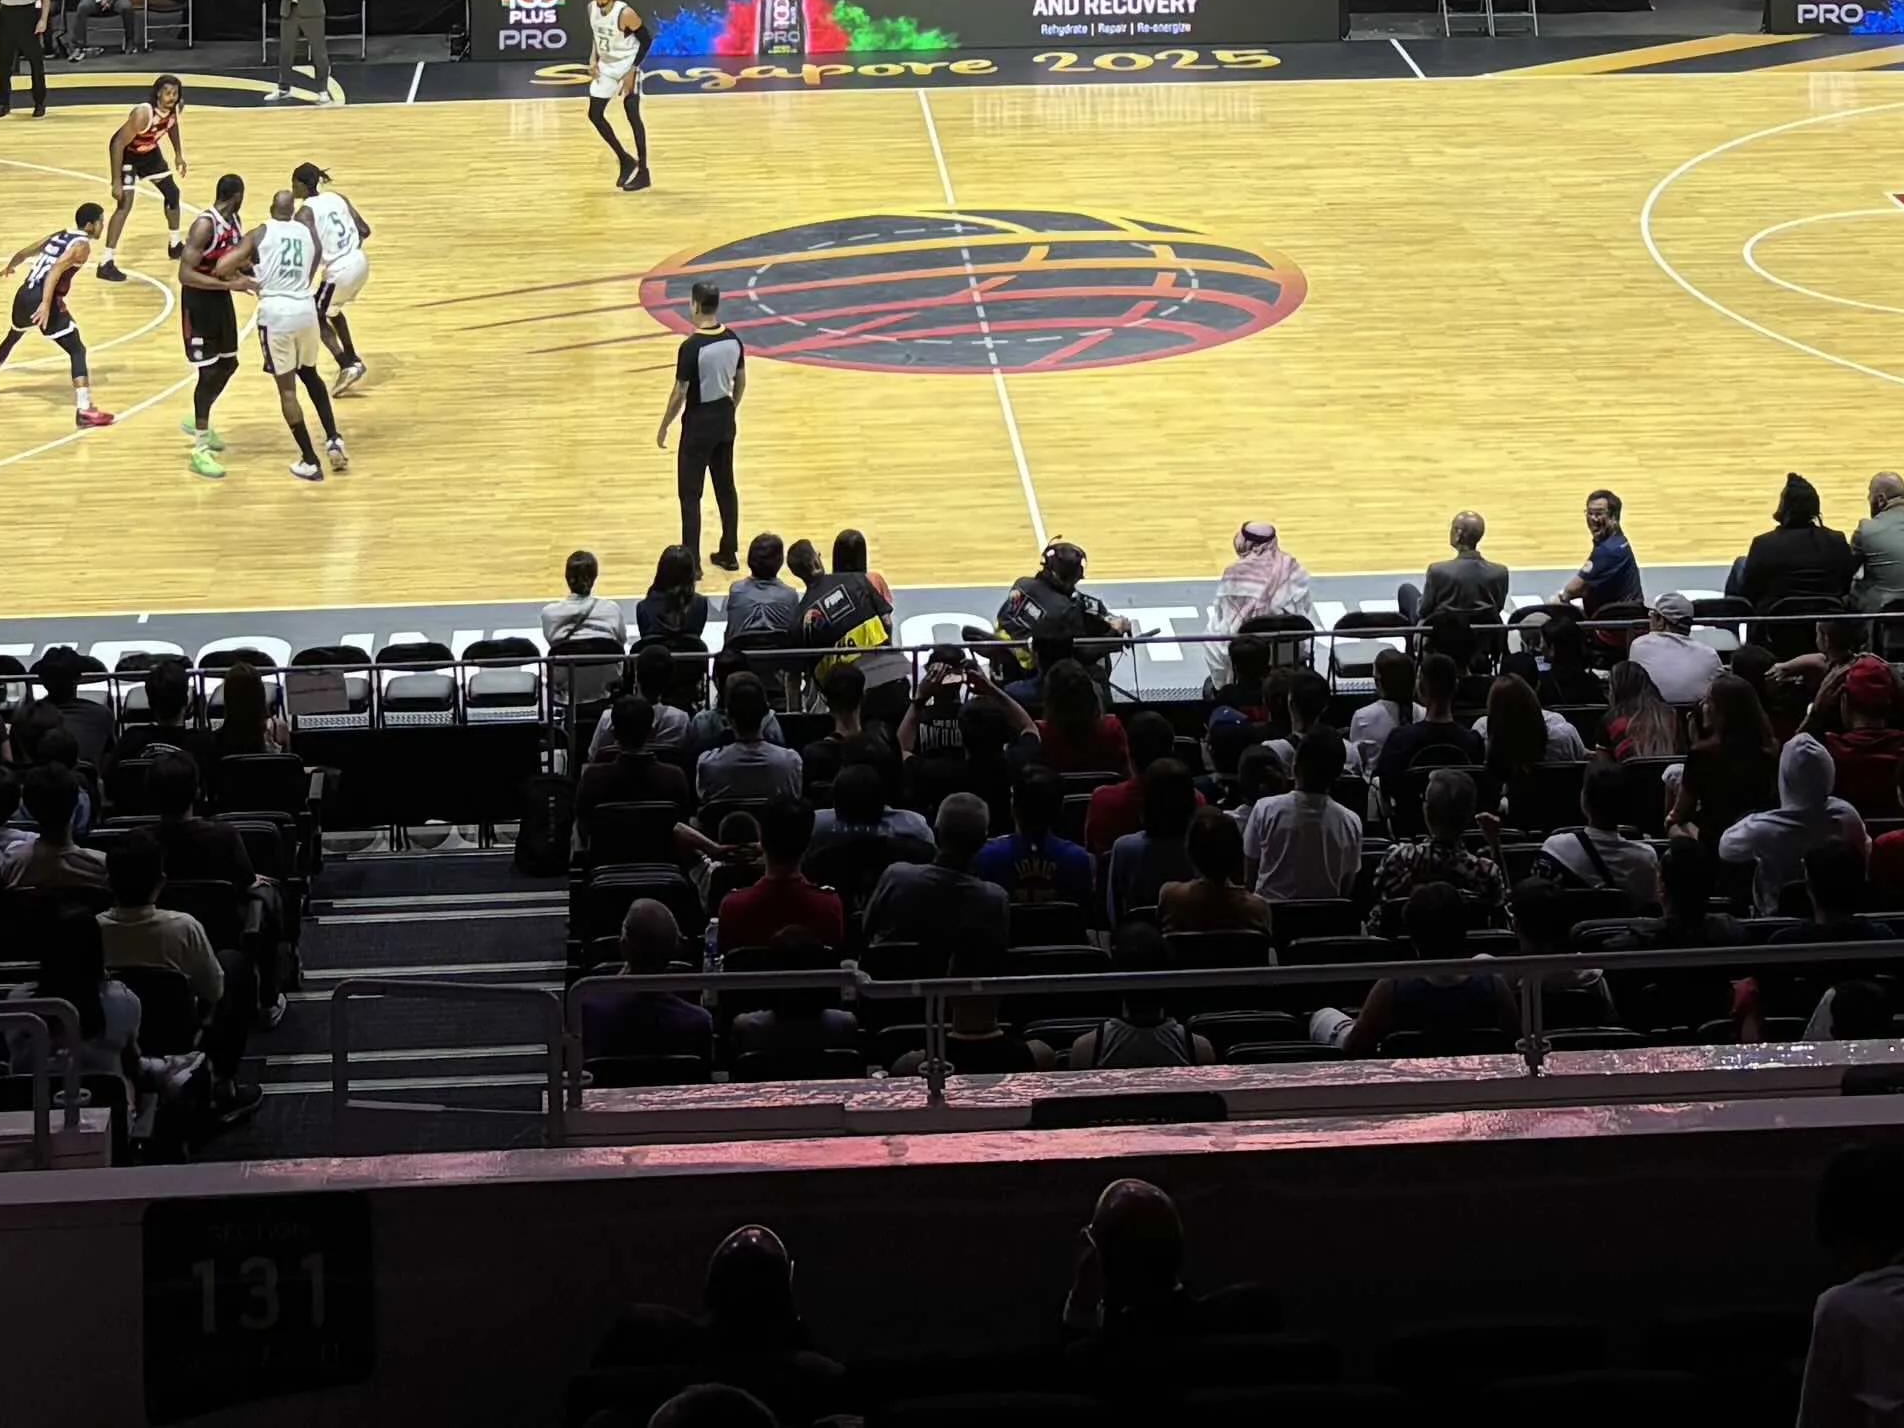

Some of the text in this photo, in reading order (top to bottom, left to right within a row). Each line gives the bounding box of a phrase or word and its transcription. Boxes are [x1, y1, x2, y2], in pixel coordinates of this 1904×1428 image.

[509, 10, 556, 25] PLUS
[1798, 4, 1864, 25] PRO
[499, 29, 567, 50] PRO
[529, 49, 1282, 90] Sngapore 2025
[280, 236, 304, 268] 28
[191, 1250, 326, 1336] 131
